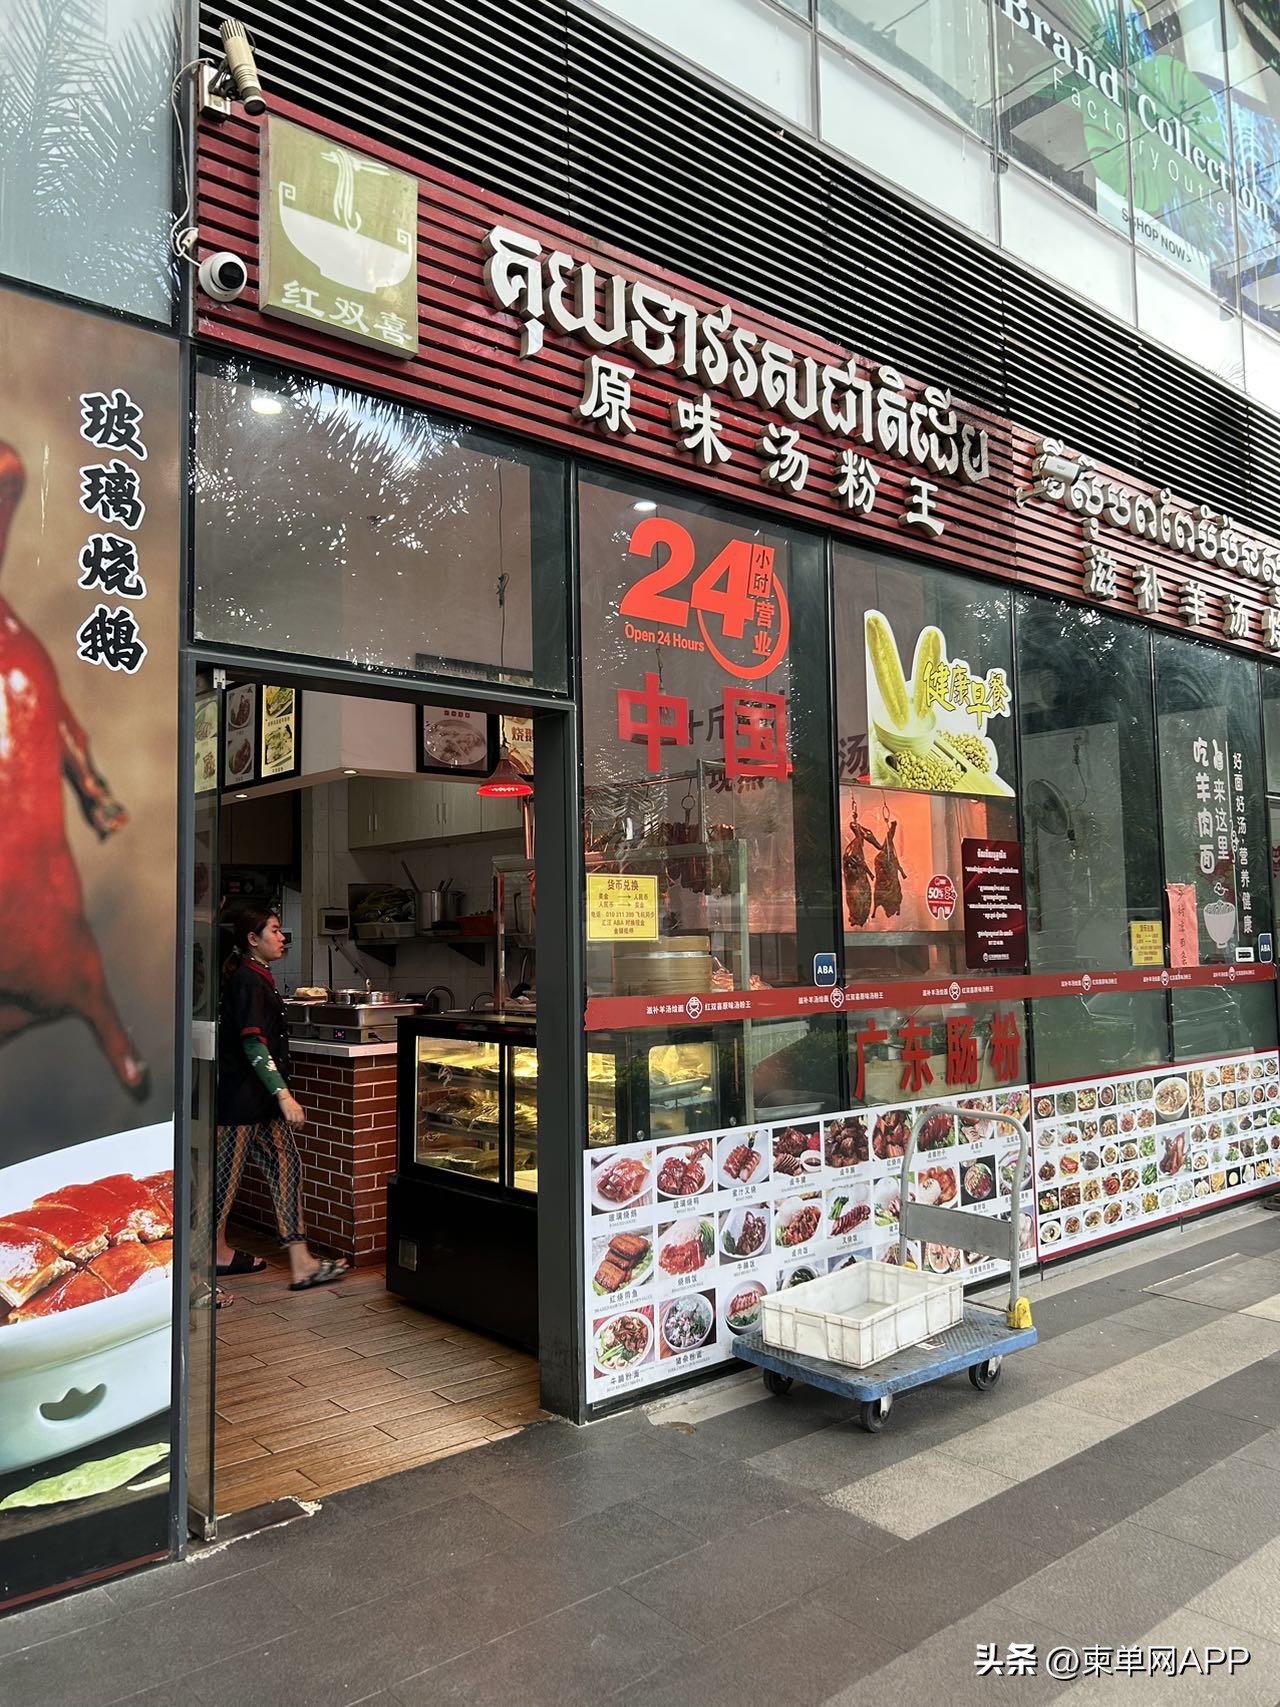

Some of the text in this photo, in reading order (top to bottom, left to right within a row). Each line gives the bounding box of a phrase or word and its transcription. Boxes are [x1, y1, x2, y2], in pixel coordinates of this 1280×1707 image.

[1002, 0, 1269, 223] Brand Collecton
[1053, 67, 1226, 219] Factory Outle
[282, 279, 414, 350] 红双喜
[574, 354, 945, 538] 原味汤粉王
[77, 388, 148, 674] 玻璃烧鹅
[619, 517, 757, 639] 24
[624, 624, 705, 653] Open 24 Hours
[617, 672, 789, 782] 中国
[922, 660, 1011, 730] 健康早餐
[1193, 737, 1215, 875] 吃羊肉面
[1213, 778, 1230, 861] 来这里
[607, 879, 639, 891] 货币兑换
[816, 964, 834, 976] ABA
[1260, 944, 1271, 953] ABA
[854, 1011, 1022, 1102] 广东肠粉
